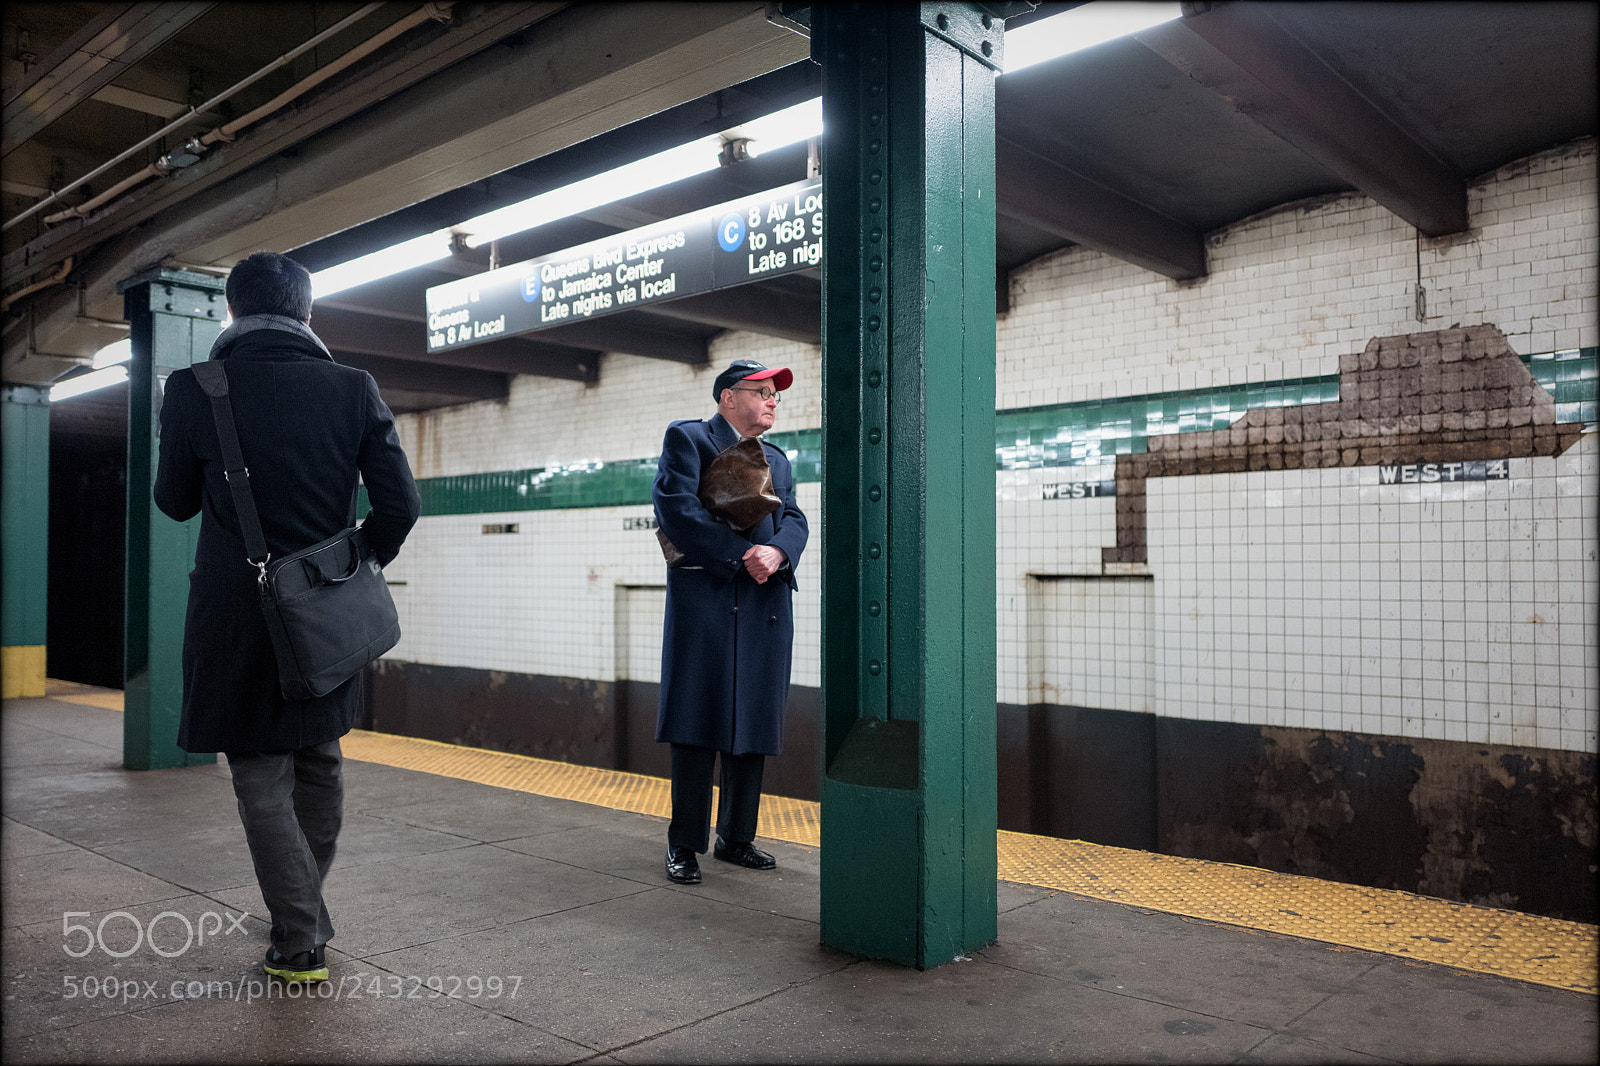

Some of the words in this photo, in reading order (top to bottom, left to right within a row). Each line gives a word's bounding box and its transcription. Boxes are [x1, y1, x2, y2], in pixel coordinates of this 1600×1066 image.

[748, 206, 761, 228] 8
[767, 200, 789, 223] Av
[724, 221, 739, 244] C
[748, 231, 767, 251] to
[772, 217, 806, 245] 168
[811, 212, 823, 235] S
[541, 257, 590, 284] Queens
[593, 243, 623, 270] Blvd
[626, 231, 686, 261] Express
[748, 249, 787, 275] Late
[525, 276, 536, 296] E
[541, 285, 555, 303] to
[558, 271, 613, 299] Jamaica
[615, 257, 664, 284] Center
[541, 300, 570, 322] Late
[572, 290, 613, 316] nights
[616, 284, 637, 304] via
[640, 272, 676, 299] local
[429, 330, 446, 349] via
[447, 327, 456, 345] 8
[474, 314, 505, 338] Local
[1380, 463, 1462, 484] WEST
[1487, 460, 1508, 479] 4
[1042, 482, 1100, 500] WEST
